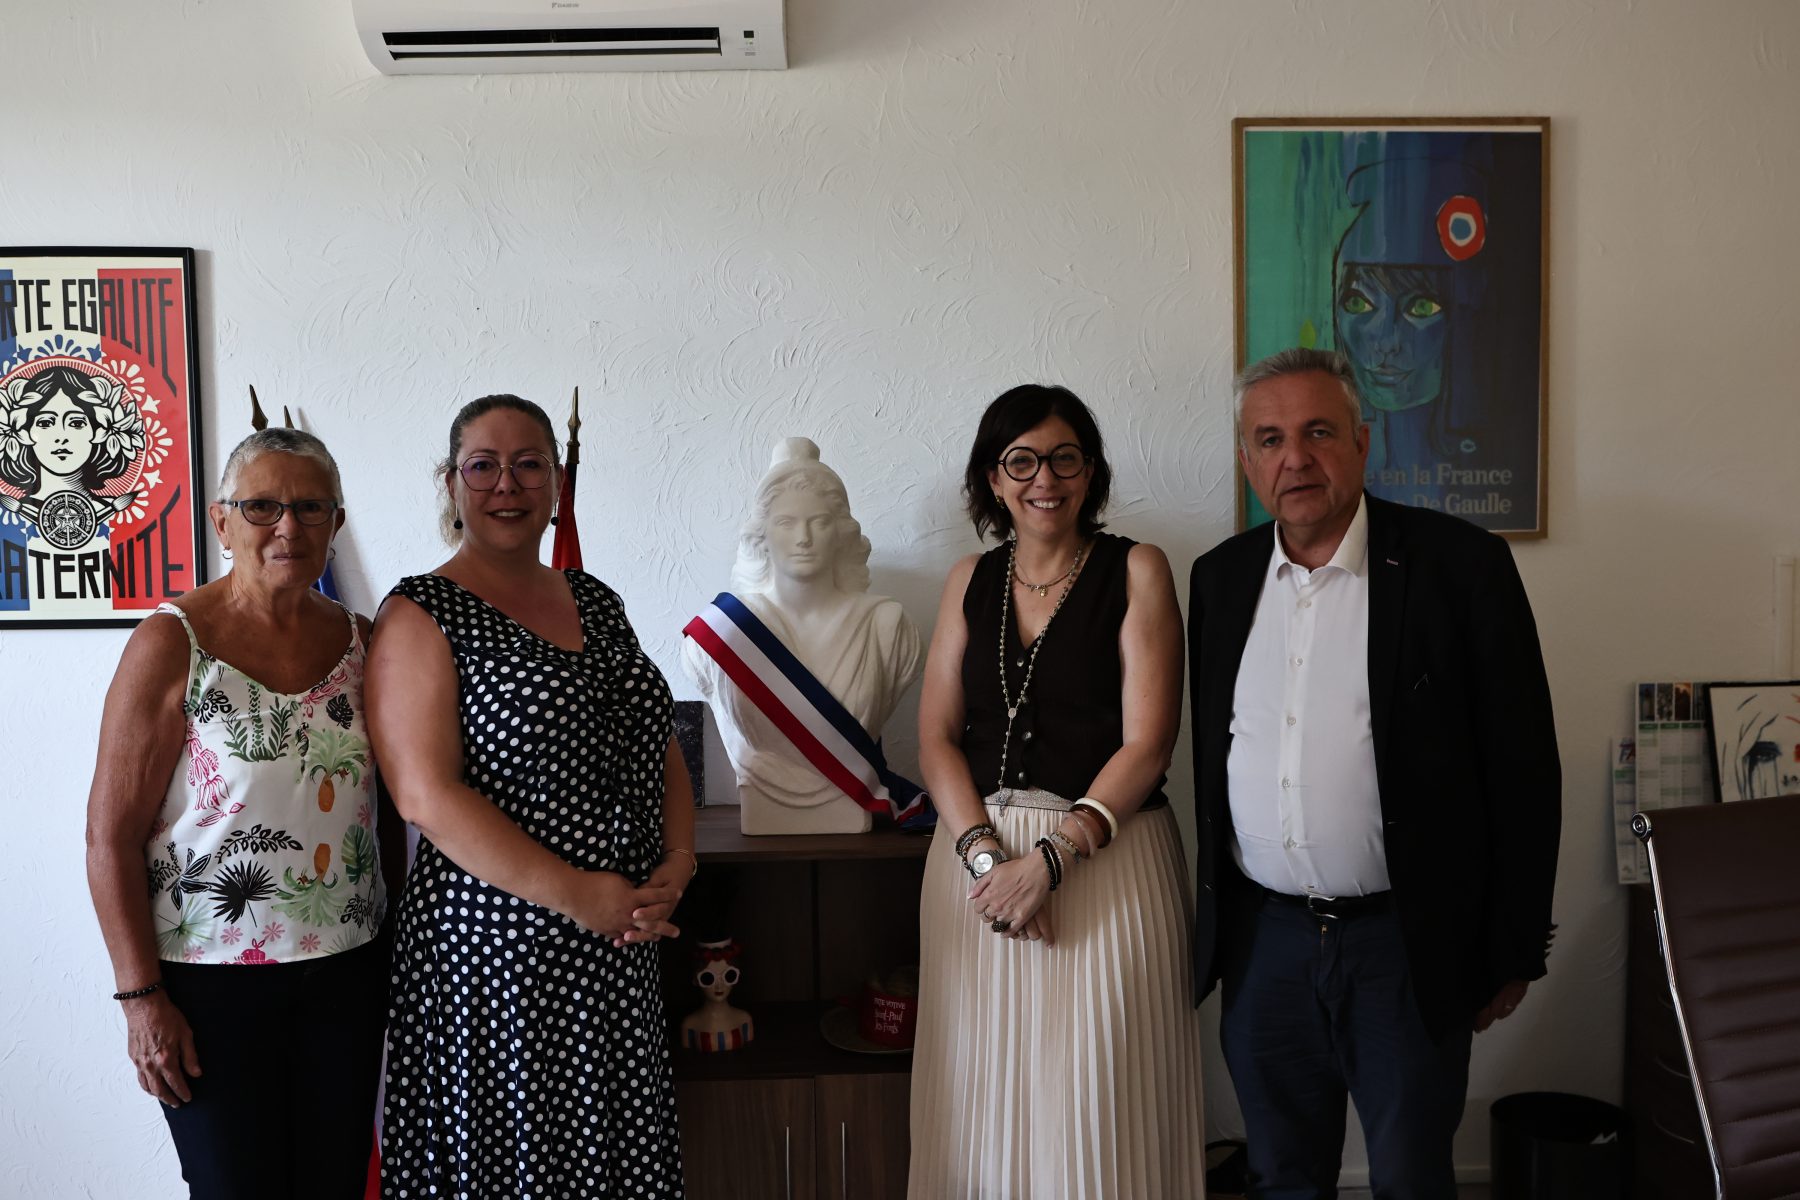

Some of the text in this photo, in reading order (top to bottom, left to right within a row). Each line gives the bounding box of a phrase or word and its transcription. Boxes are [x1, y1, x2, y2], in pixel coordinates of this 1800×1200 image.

[62, 277, 178, 398] EGALITE
[1380, 470, 1408, 486] en
[1412, 463, 1431, 486] la
[1436, 463, 1513, 486] France
[1445, 491, 1513, 515] Gaulle
[0, 484, 184, 600] ATERNITE
